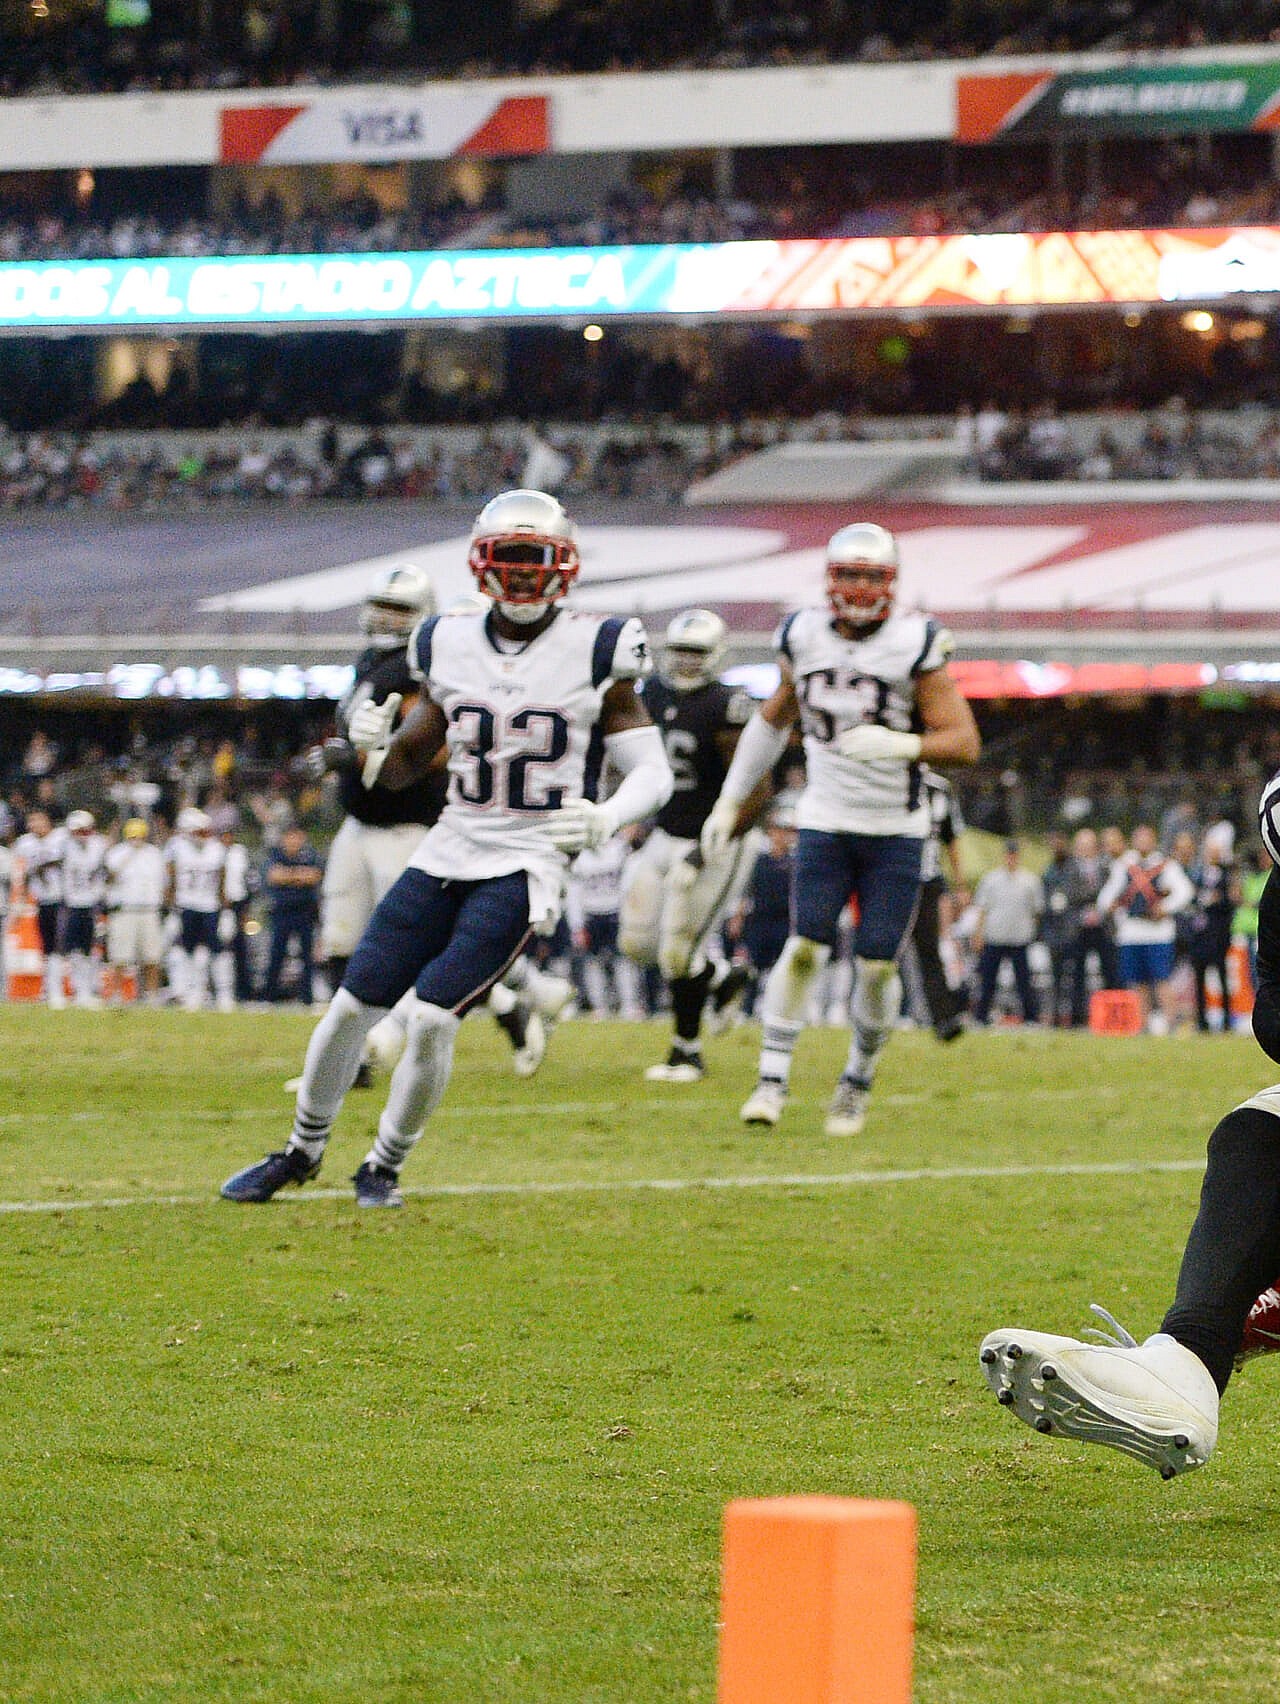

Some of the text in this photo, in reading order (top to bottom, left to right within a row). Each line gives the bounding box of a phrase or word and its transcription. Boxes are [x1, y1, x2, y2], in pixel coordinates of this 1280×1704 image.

[341, 108, 426, 146] VISA
[110, 266, 183, 315] AL
[449, 702, 571, 816] 32
